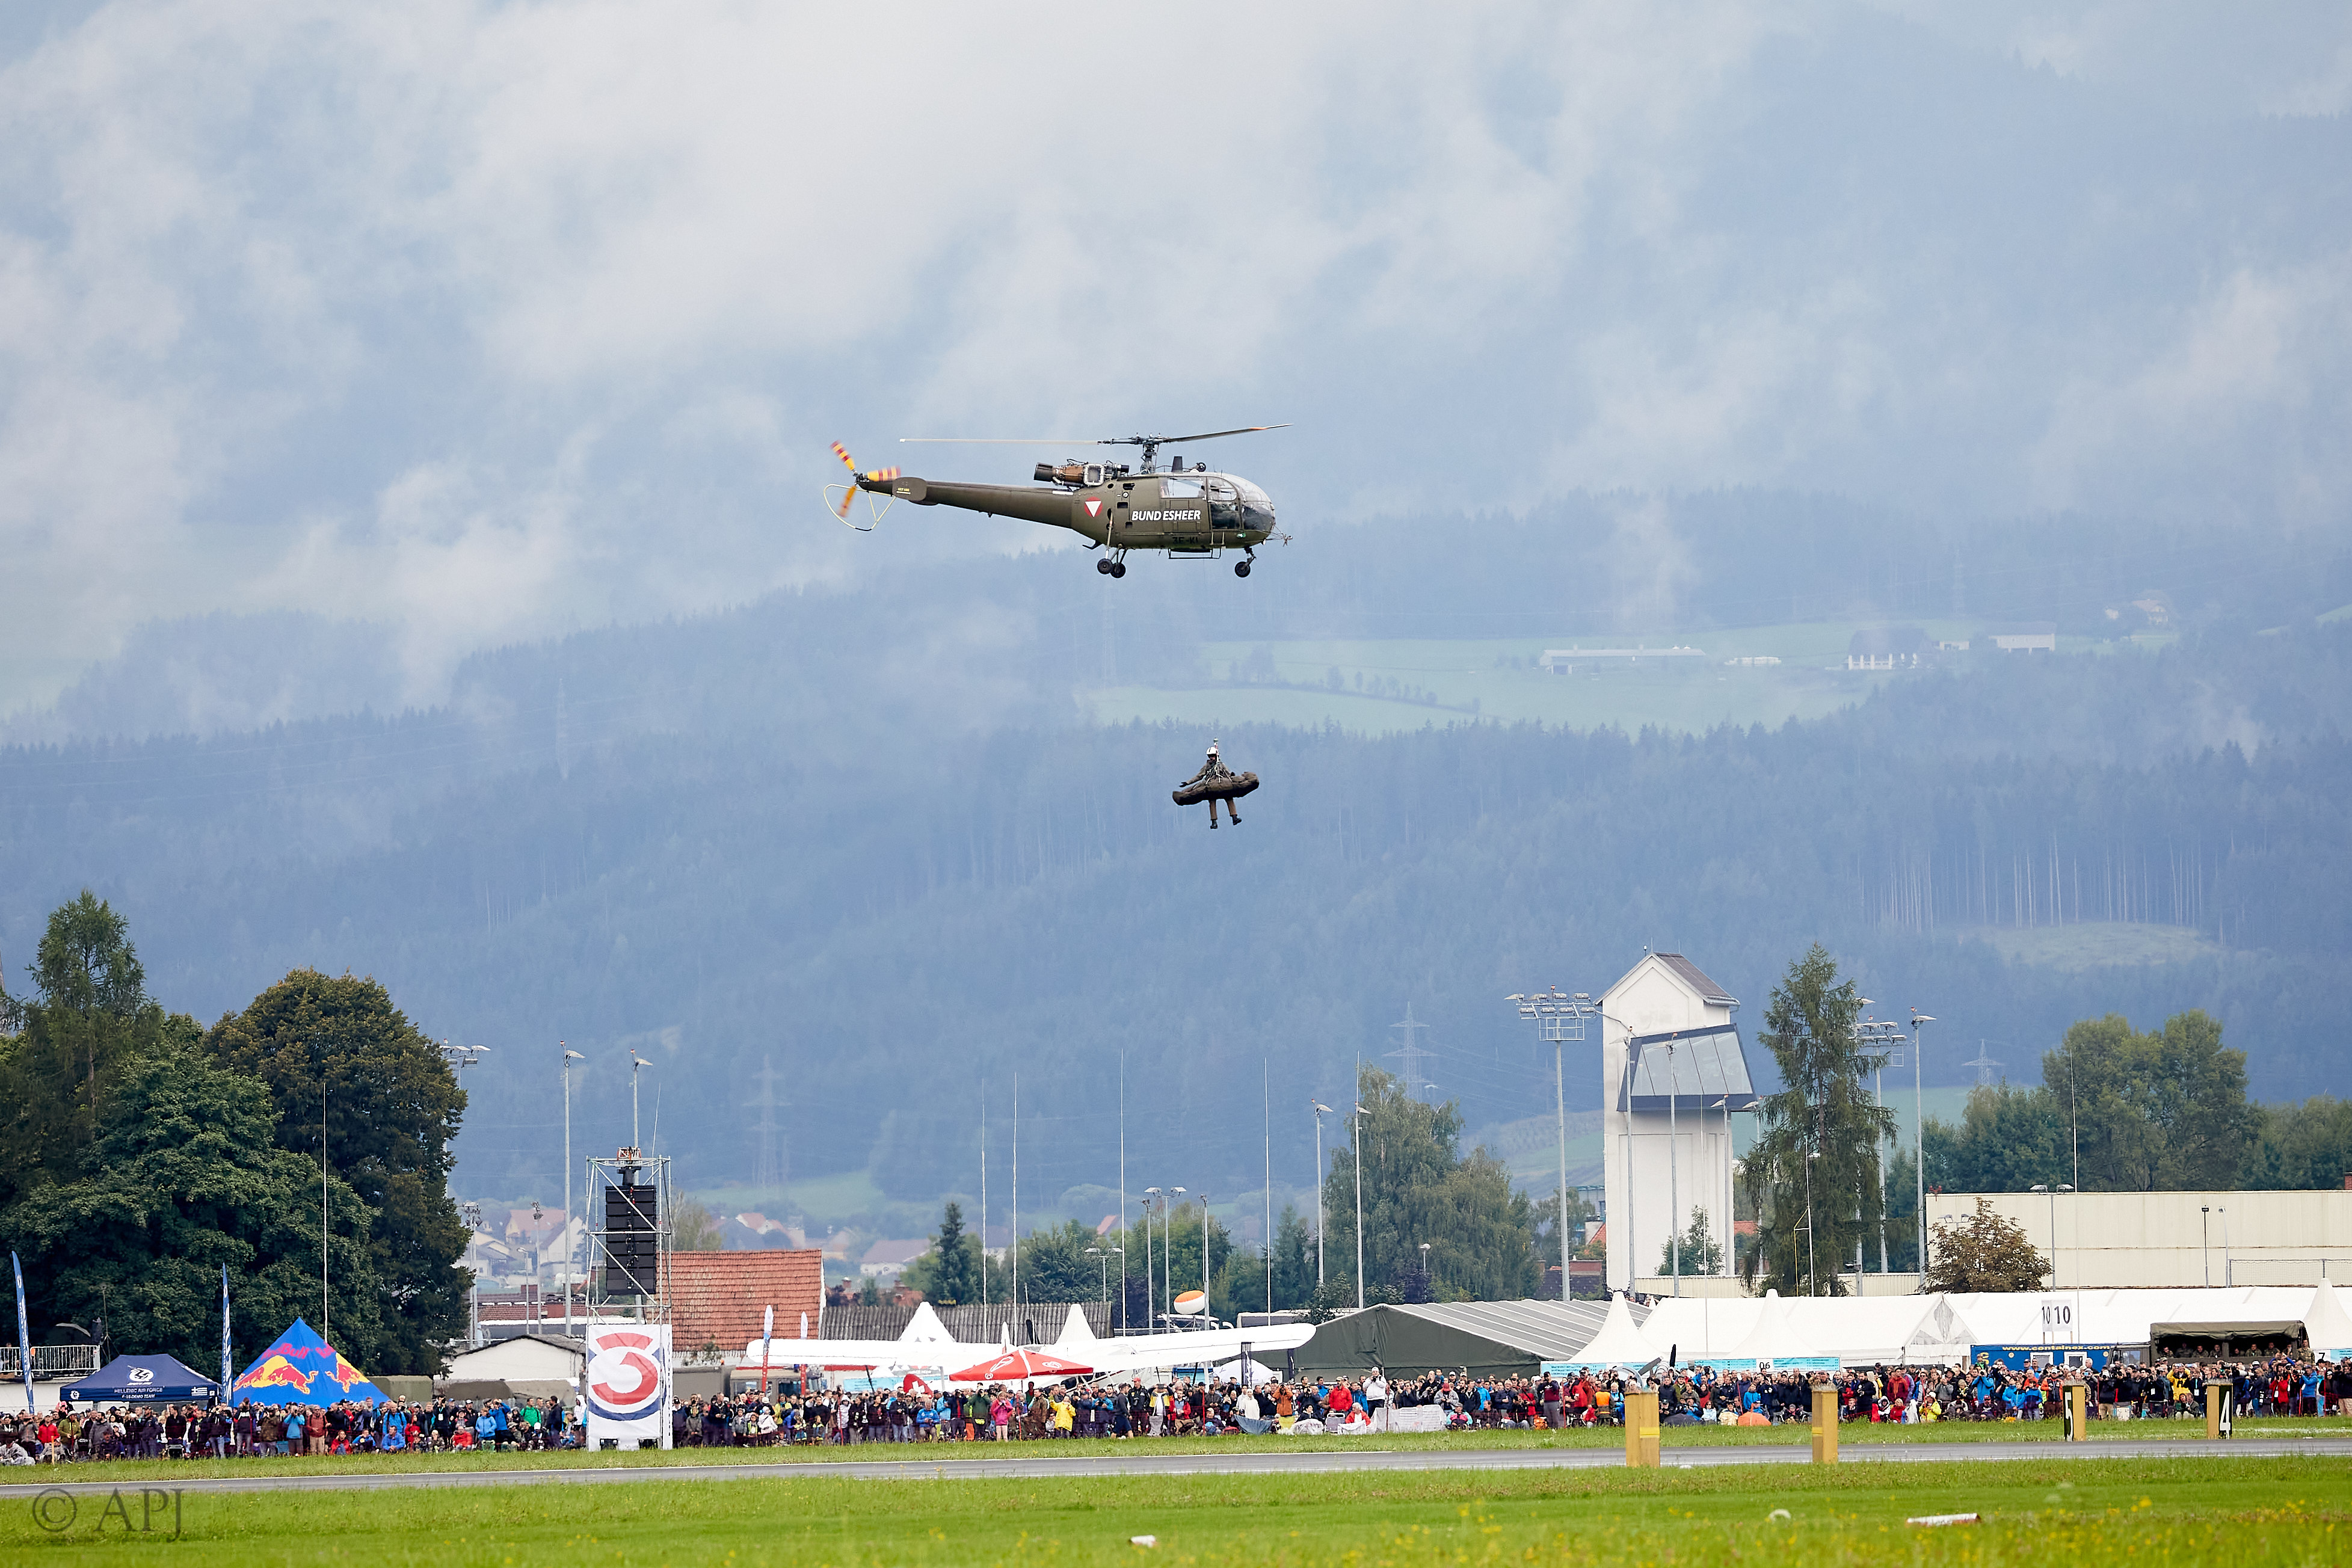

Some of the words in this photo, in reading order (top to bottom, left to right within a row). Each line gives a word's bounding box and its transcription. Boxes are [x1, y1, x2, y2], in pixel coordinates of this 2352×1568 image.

[2042, 1306, 2051, 1324] 10
[2054, 1306, 2070, 1324] 10
[2064, 1391, 2073, 1442] 5
[2220, 1391, 2231, 1440] 4
